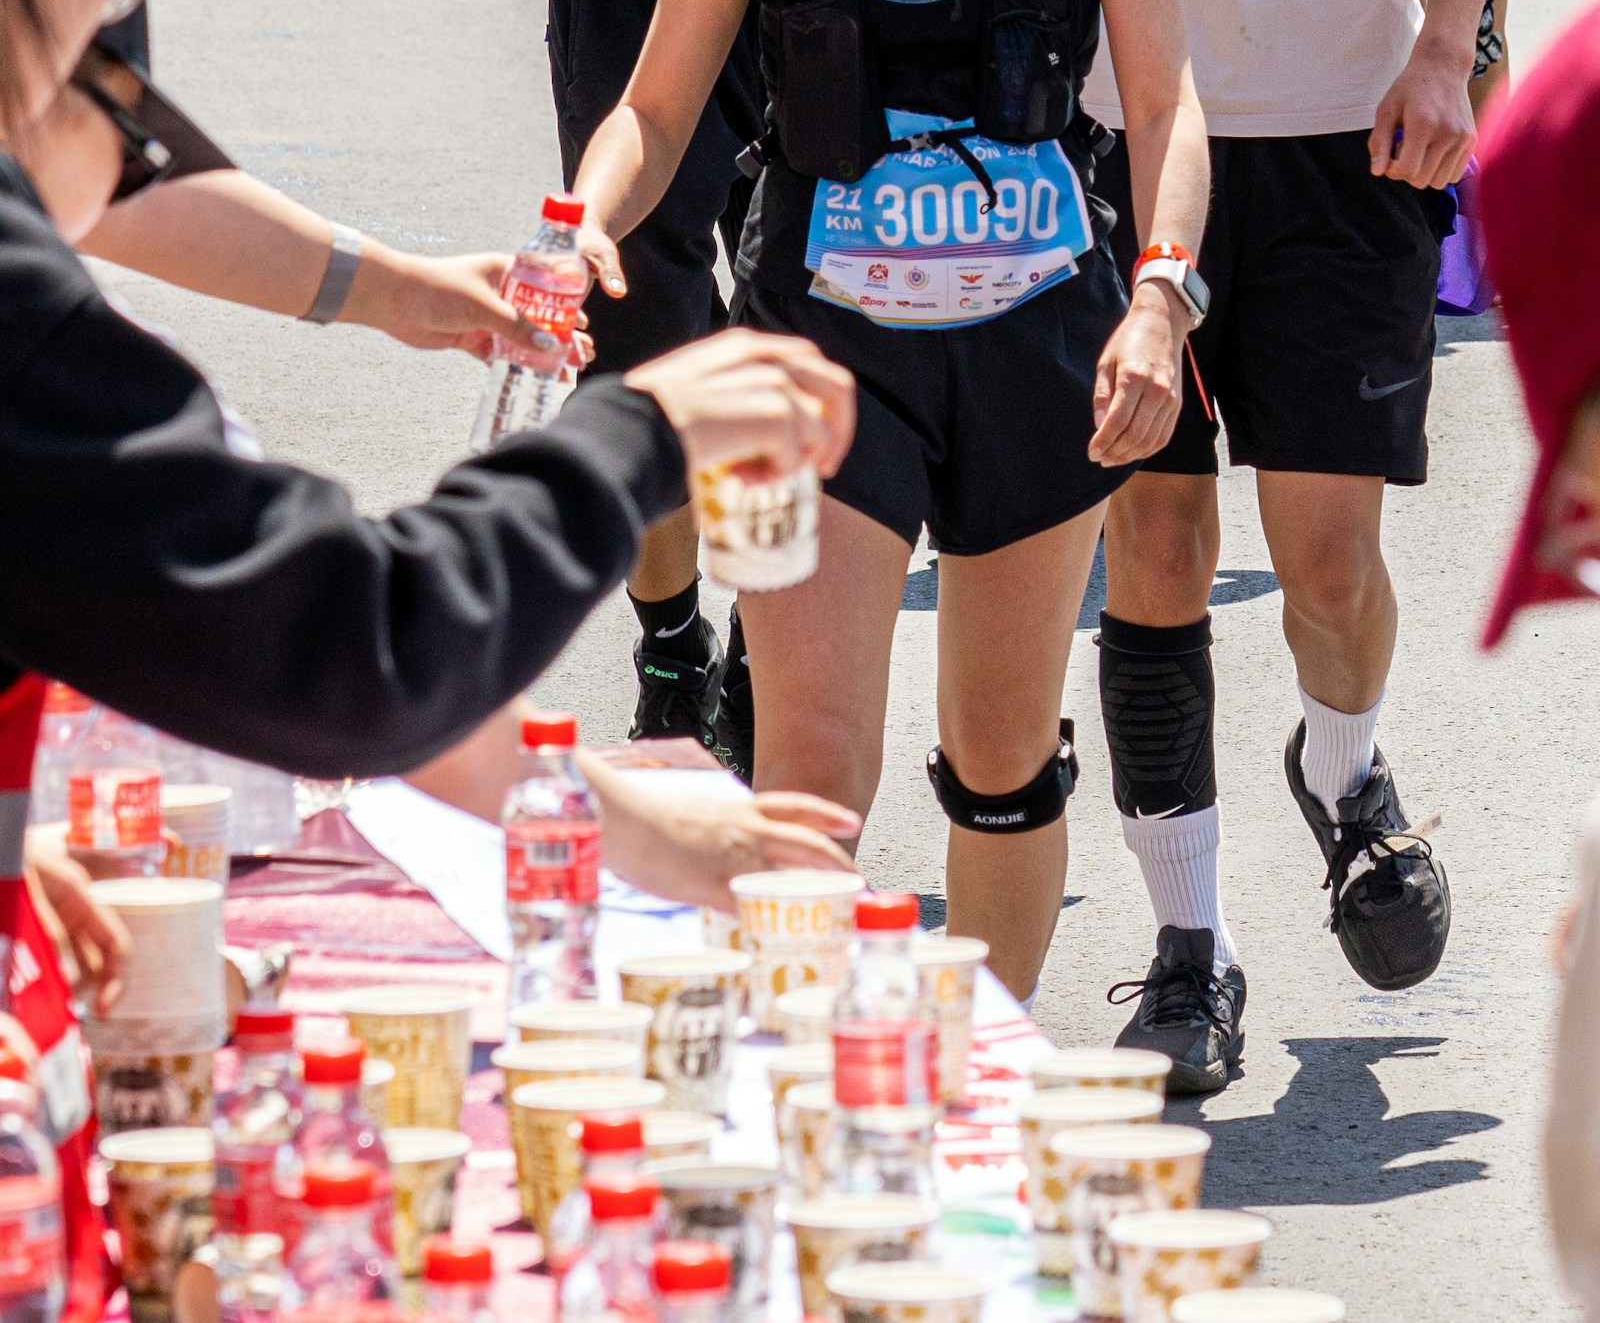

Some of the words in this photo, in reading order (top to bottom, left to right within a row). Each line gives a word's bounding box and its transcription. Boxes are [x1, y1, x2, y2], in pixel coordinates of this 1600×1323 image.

[826, 184, 862, 211] 21
[874, 178, 1059, 246] 30090
[826, 214, 863, 231] KM
[515, 286, 579, 309] ALKALIN
[655, 669, 679, 679] asics
[973, 812, 1026, 825] AONIJIE
